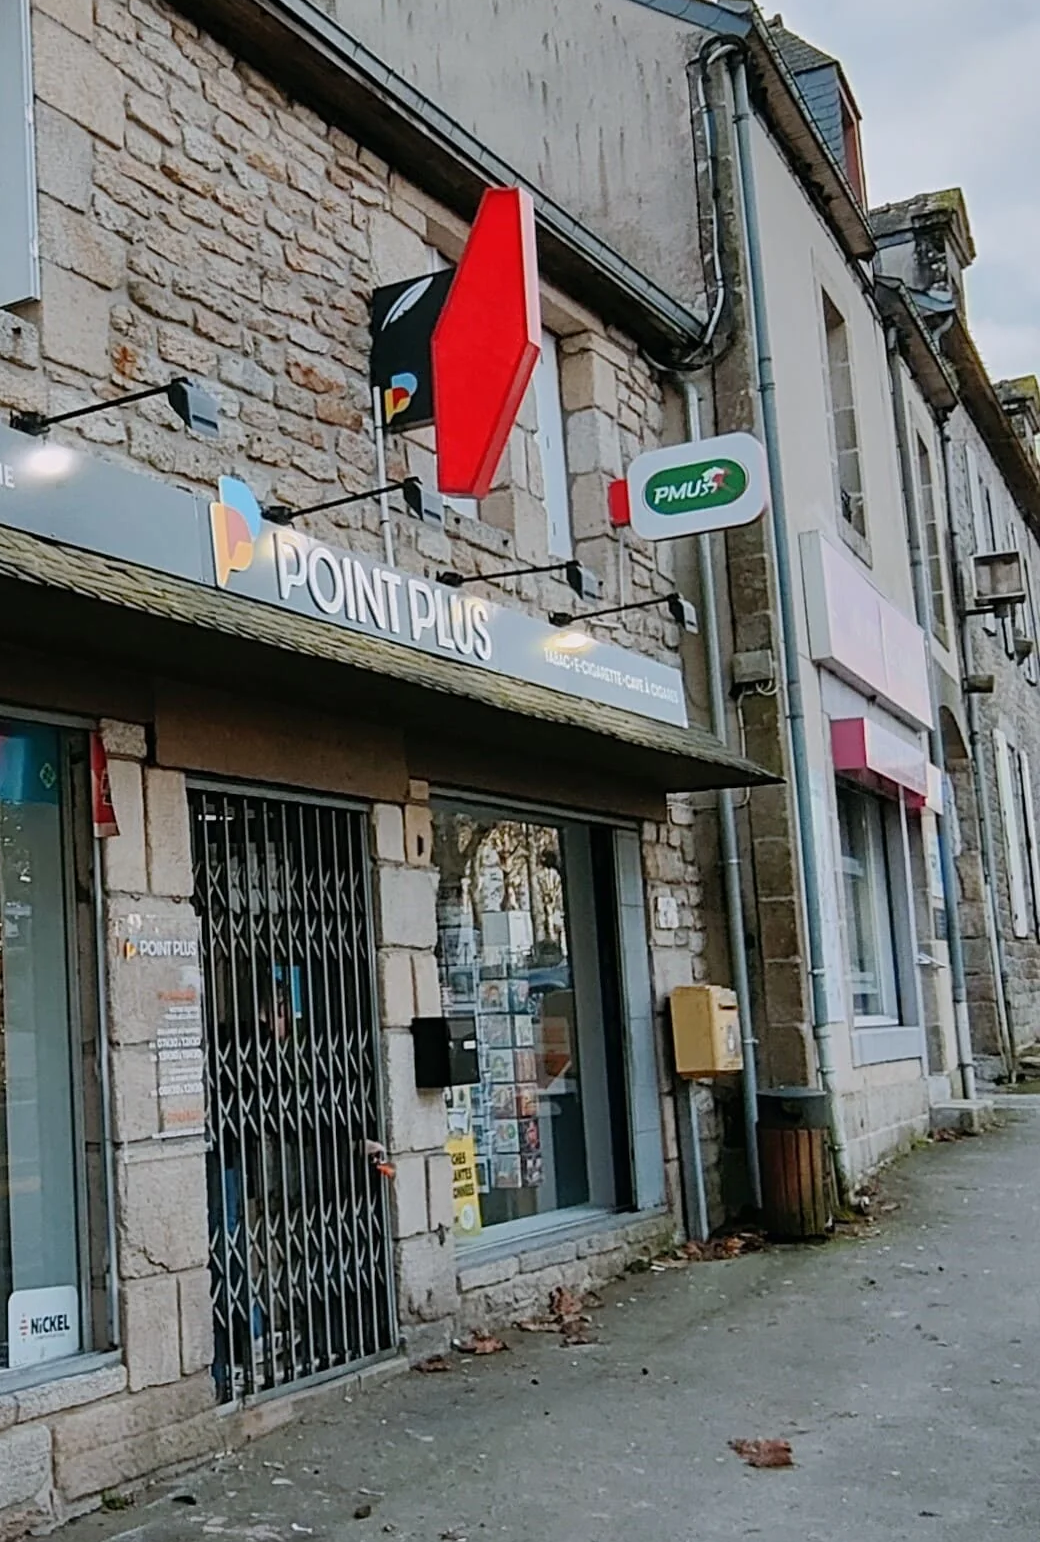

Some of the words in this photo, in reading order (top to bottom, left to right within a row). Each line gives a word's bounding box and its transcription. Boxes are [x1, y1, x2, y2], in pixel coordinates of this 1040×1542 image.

[653, 479, 702, 505] PMU
[273, 531, 402, 635] POINT
[408, 578, 493, 661] PLUS
[140, 940, 172, 957] POINT
[173, 940, 197, 957] PLUS
